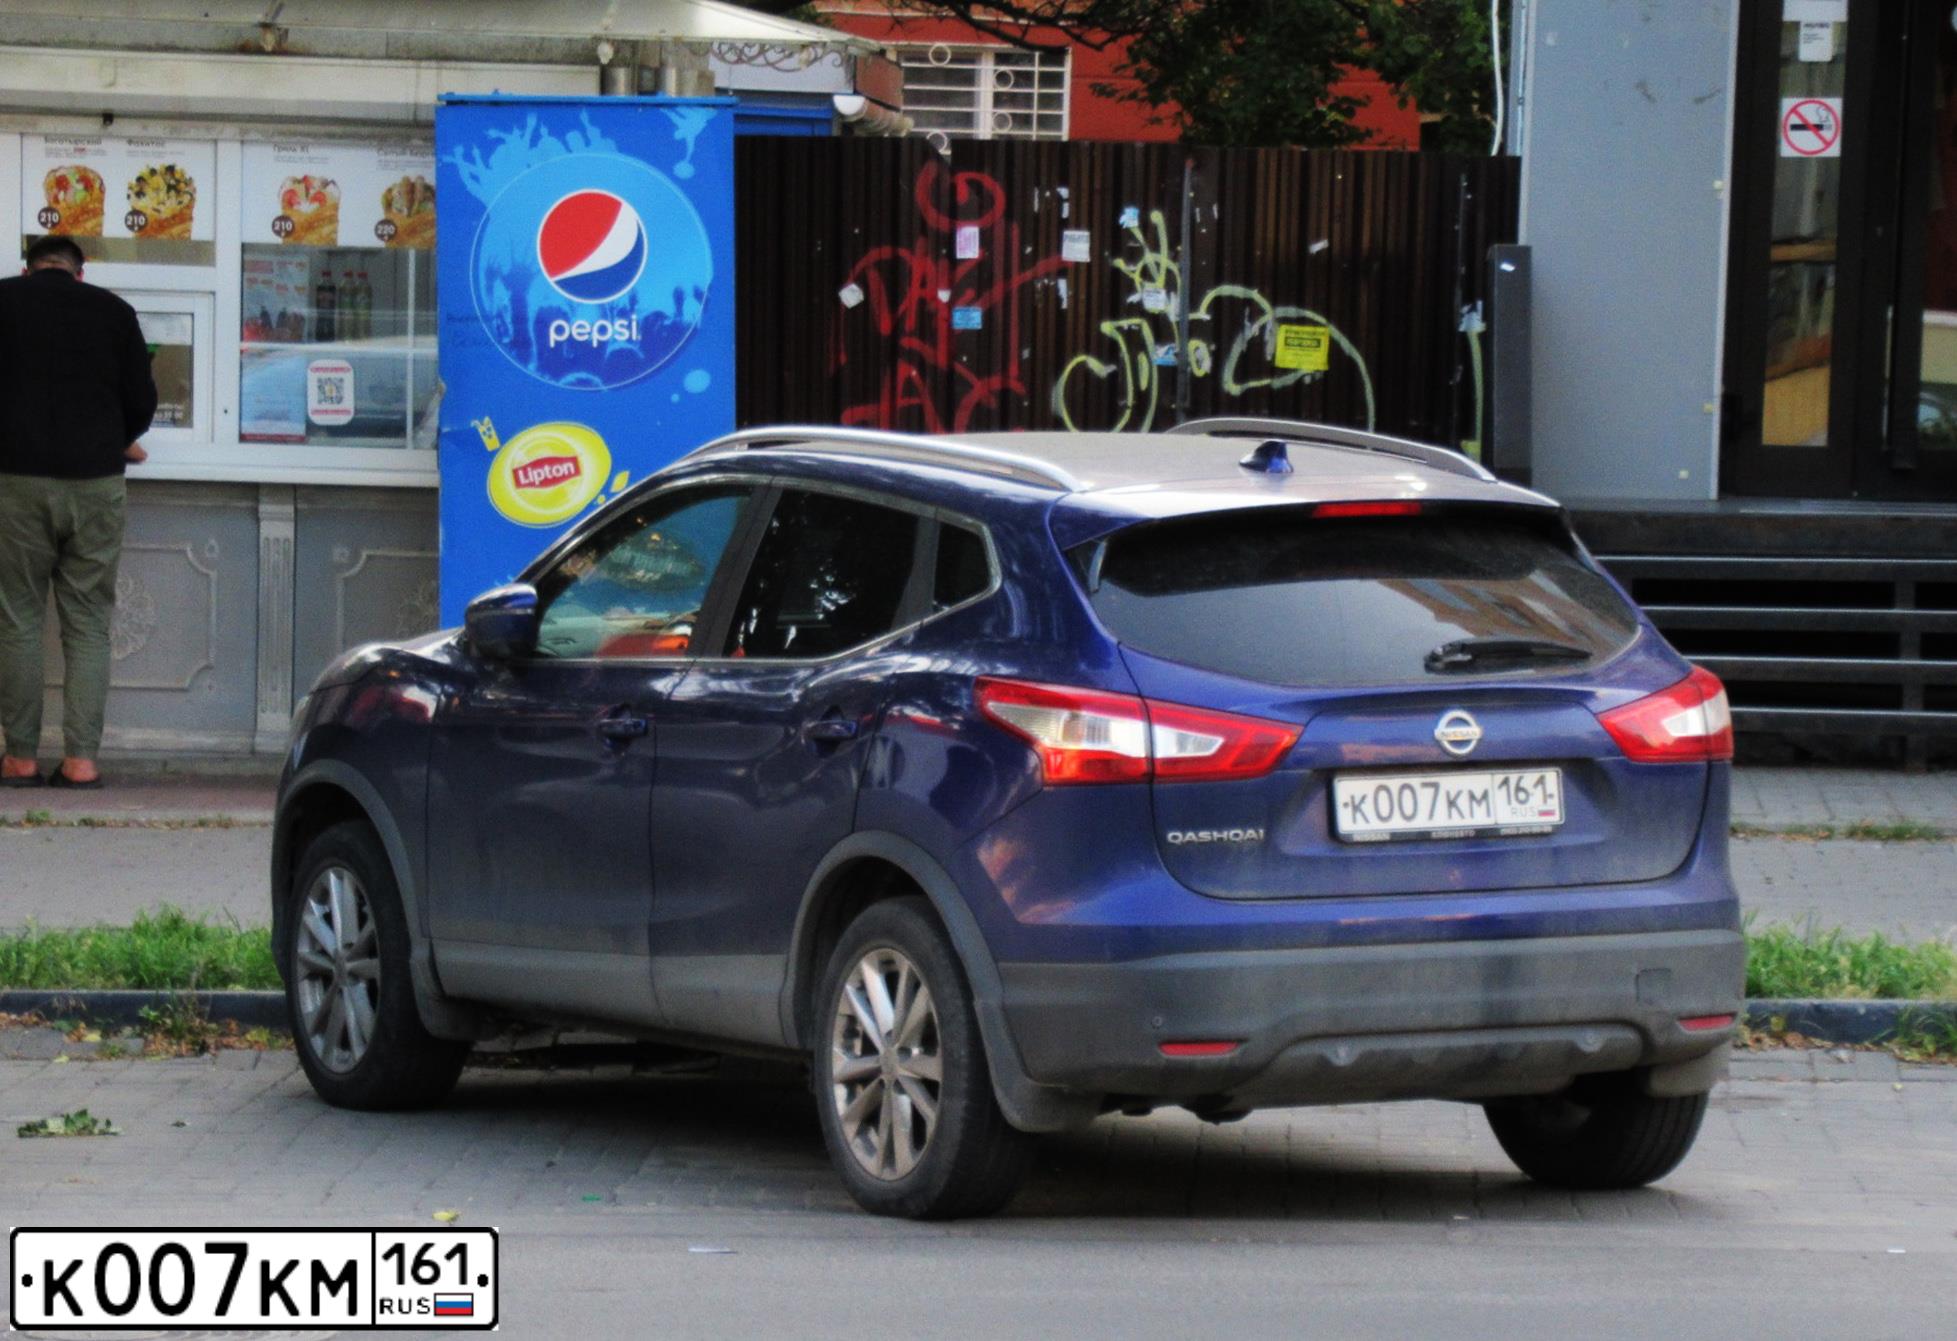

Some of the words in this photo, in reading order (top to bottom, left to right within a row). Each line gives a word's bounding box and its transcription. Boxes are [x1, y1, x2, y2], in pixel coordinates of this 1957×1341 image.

[40, 212, 60, 223] 210
[126, 215, 146, 226] 210
[273, 220, 293, 232] 210
[549, 315, 637, 348] pepsi
[517, 461, 575, 485] Lipton
[1498, 775, 1547, 806] 161
[1511, 807, 1537, 817] RUS
[1167, 829, 1264, 843] QASHQAI
